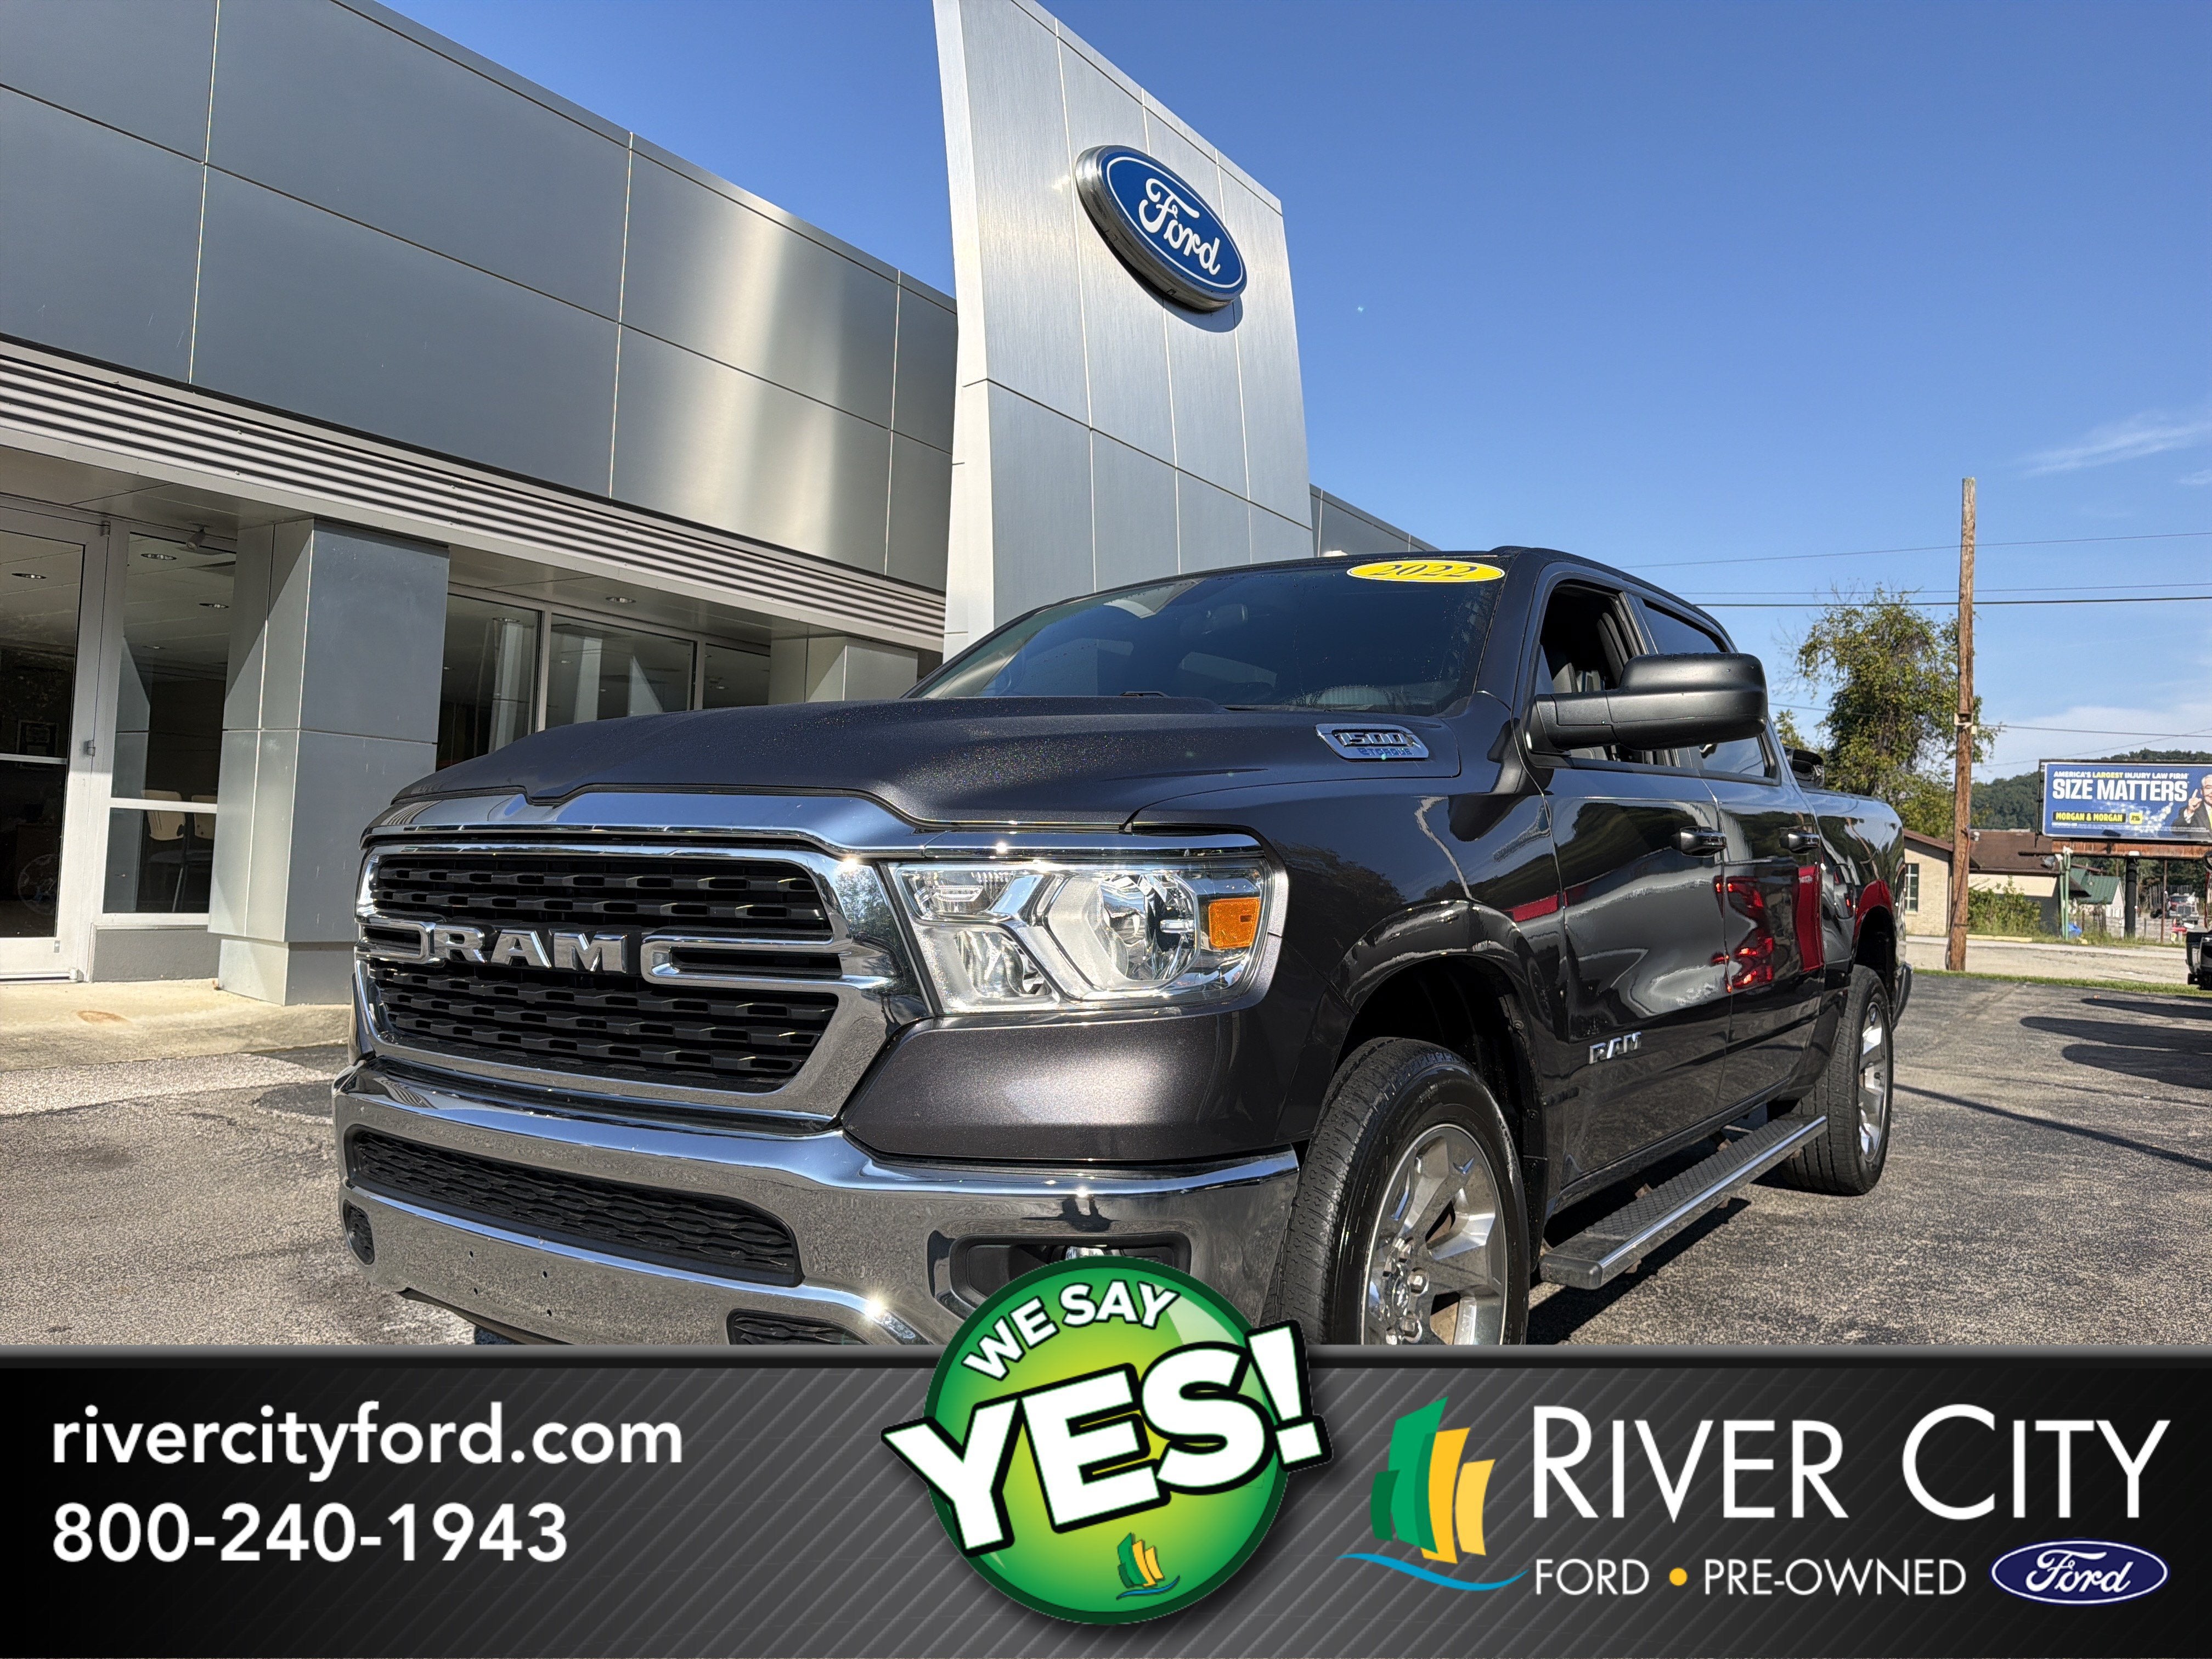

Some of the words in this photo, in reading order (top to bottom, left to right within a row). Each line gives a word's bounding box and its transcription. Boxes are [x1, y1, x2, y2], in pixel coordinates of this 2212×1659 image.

[1139, 178, 1220, 275] Ford
[1368, 564, 1477, 577] 2022
[2052, 778, 2093, 799] SIZE
[2097, 779, 2188, 802] MATTERS
[2056, 812, 2085, 821] MORGAN
[2086, 812, 2092, 821] &
[2093, 813, 2123, 822] MORGAN
[435, 922, 627, 974] RAM
[1589, 1031, 1642, 1064] RAM
